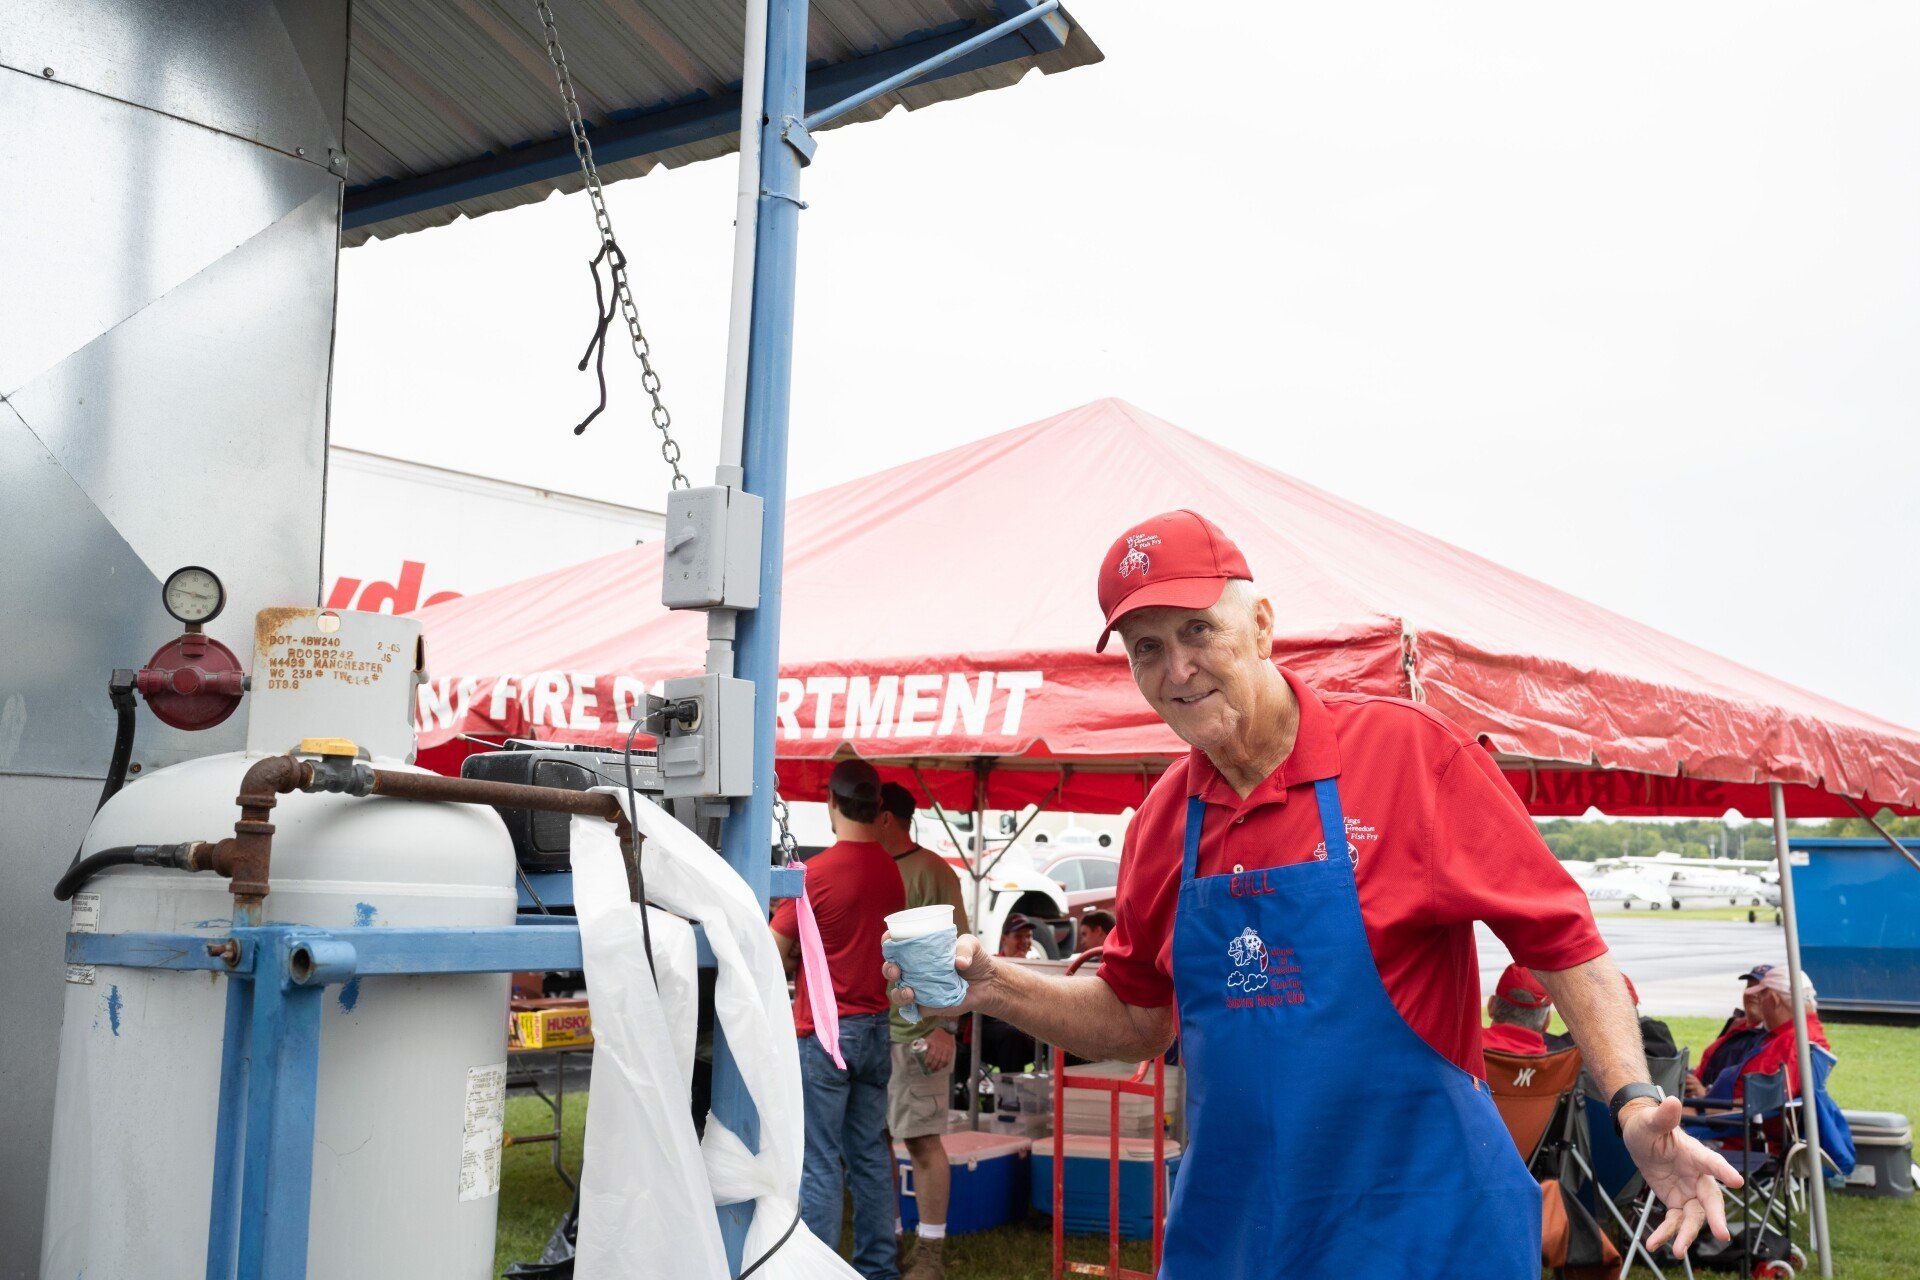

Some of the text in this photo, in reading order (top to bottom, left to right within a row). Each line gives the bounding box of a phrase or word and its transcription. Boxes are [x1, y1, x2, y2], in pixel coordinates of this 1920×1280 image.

[313, 659, 383, 673] MANCHESTER
[490, 670, 601, 731] FIRE
[1343, 816, 1361, 825] ings
[1344, 823, 1375, 834] Freedom
[1350, 832, 1379, 841] Fish Fry
[1230, 872, 1276, 898] BILL
[547, 1015, 588, 1031] HUSKY
